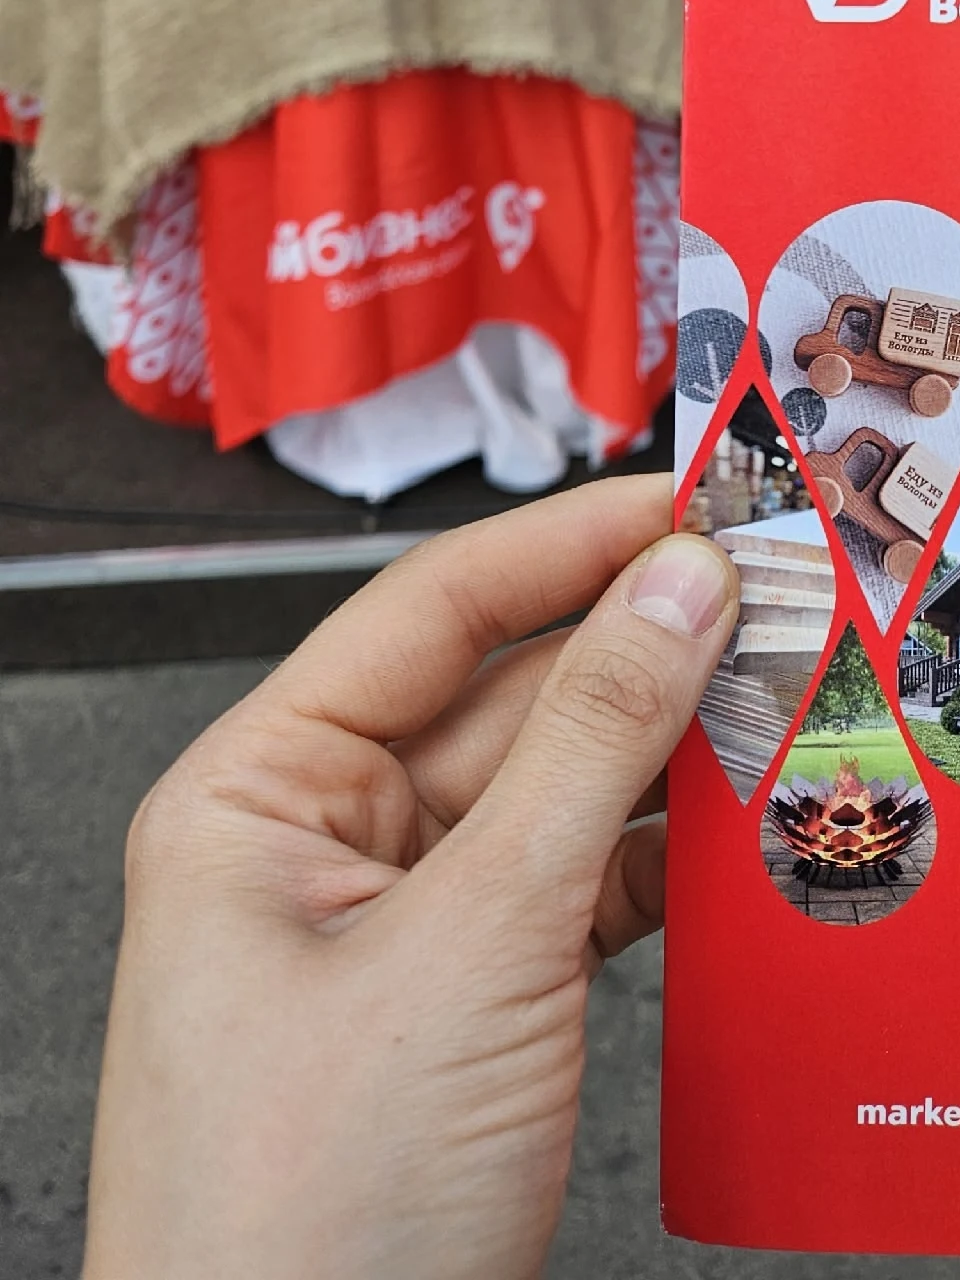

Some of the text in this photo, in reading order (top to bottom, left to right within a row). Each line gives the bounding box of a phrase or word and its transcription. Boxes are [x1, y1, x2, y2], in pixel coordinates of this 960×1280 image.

[888, 341, 935, 357] Вологды
[894, 332, 928, 345] Еду из
[897, 476, 938, 509] Вологды
[904, 465, 943, 499] Еду из
